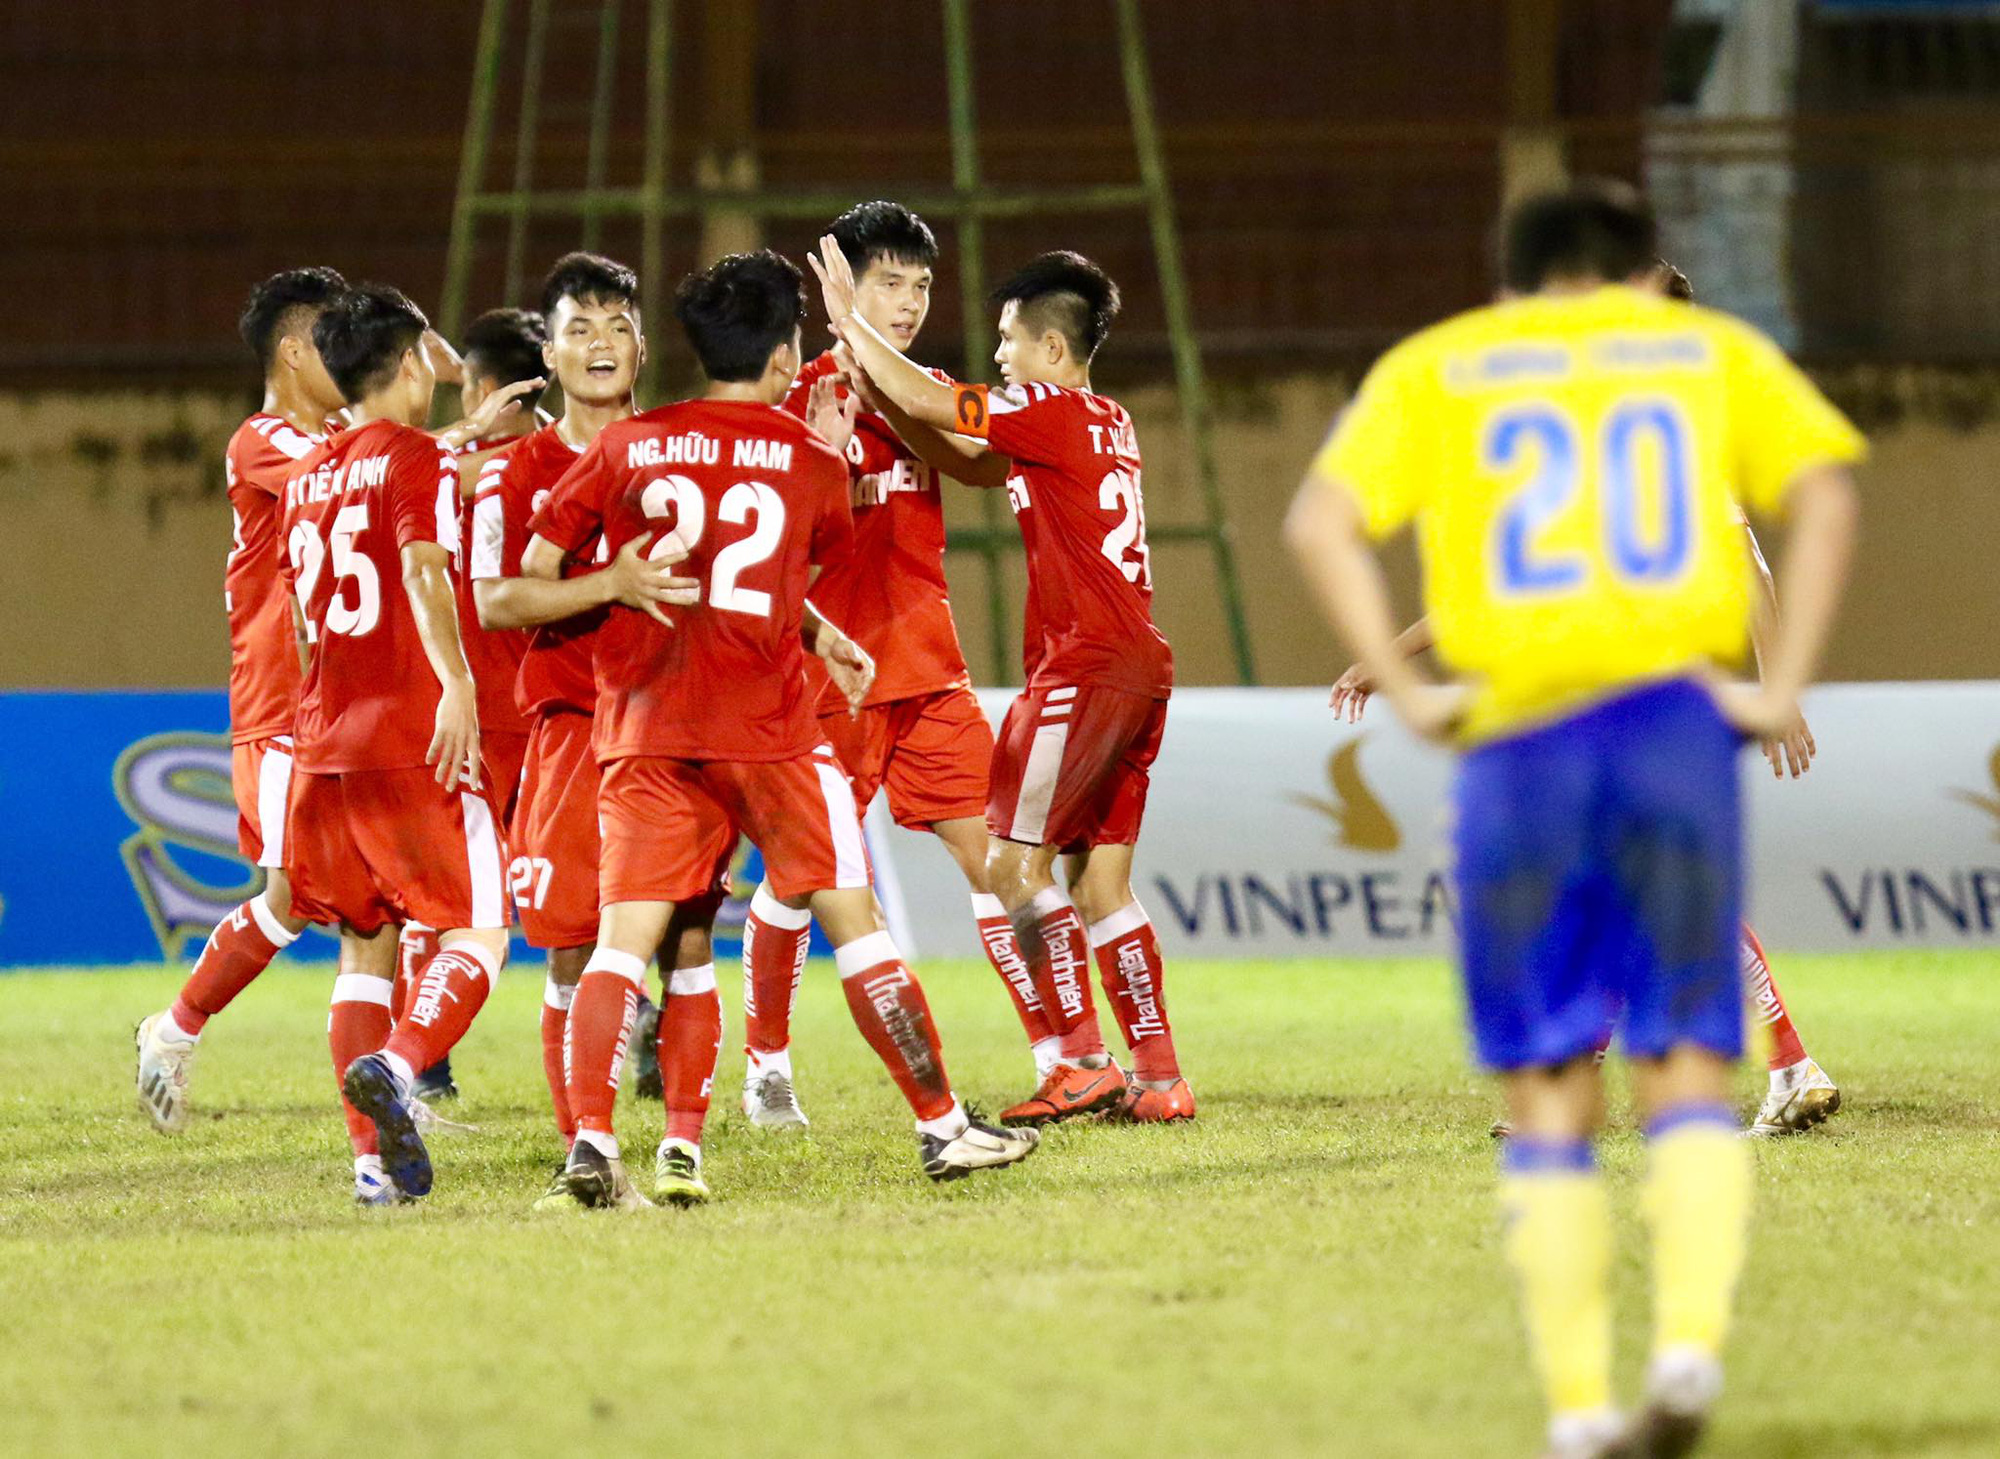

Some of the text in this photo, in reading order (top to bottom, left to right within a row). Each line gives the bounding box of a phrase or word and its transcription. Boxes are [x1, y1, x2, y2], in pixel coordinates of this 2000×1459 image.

[346, 454, 391, 491] ANH
[733, 439, 793, 471] NAM
[1489, 402, 1692, 592] 20
[289, 504, 381, 644] 25
[641, 474, 785, 617] 22
[509, 856, 554, 910] 27
[1153, 868, 1452, 941] VINPEA
